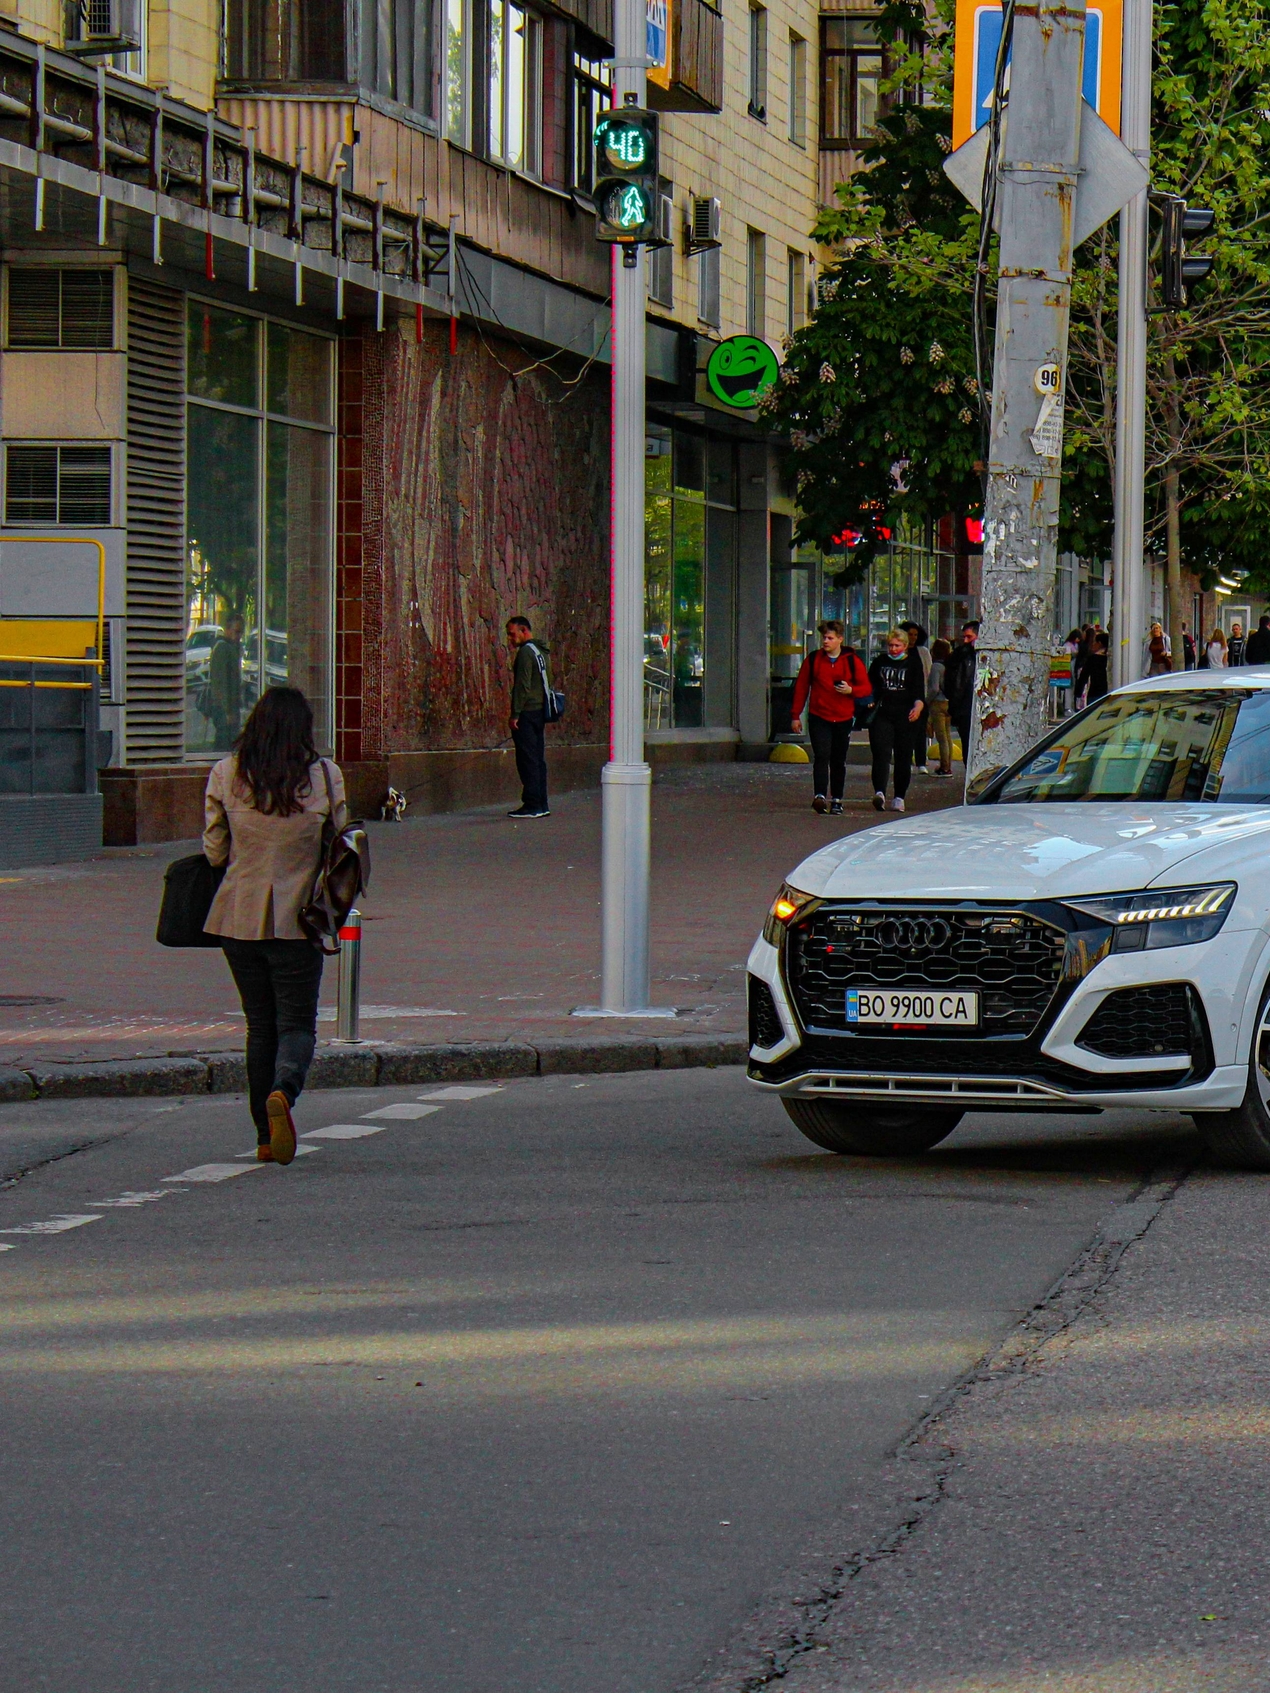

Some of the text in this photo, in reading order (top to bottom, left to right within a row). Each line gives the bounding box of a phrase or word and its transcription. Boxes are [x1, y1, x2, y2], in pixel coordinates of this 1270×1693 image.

[609, 130, 644, 162] 40
[1041, 369, 1058, 387] 96
[848, 1009, 858, 1018] UA
[858, 994, 968, 1019] BO 9900 CA
